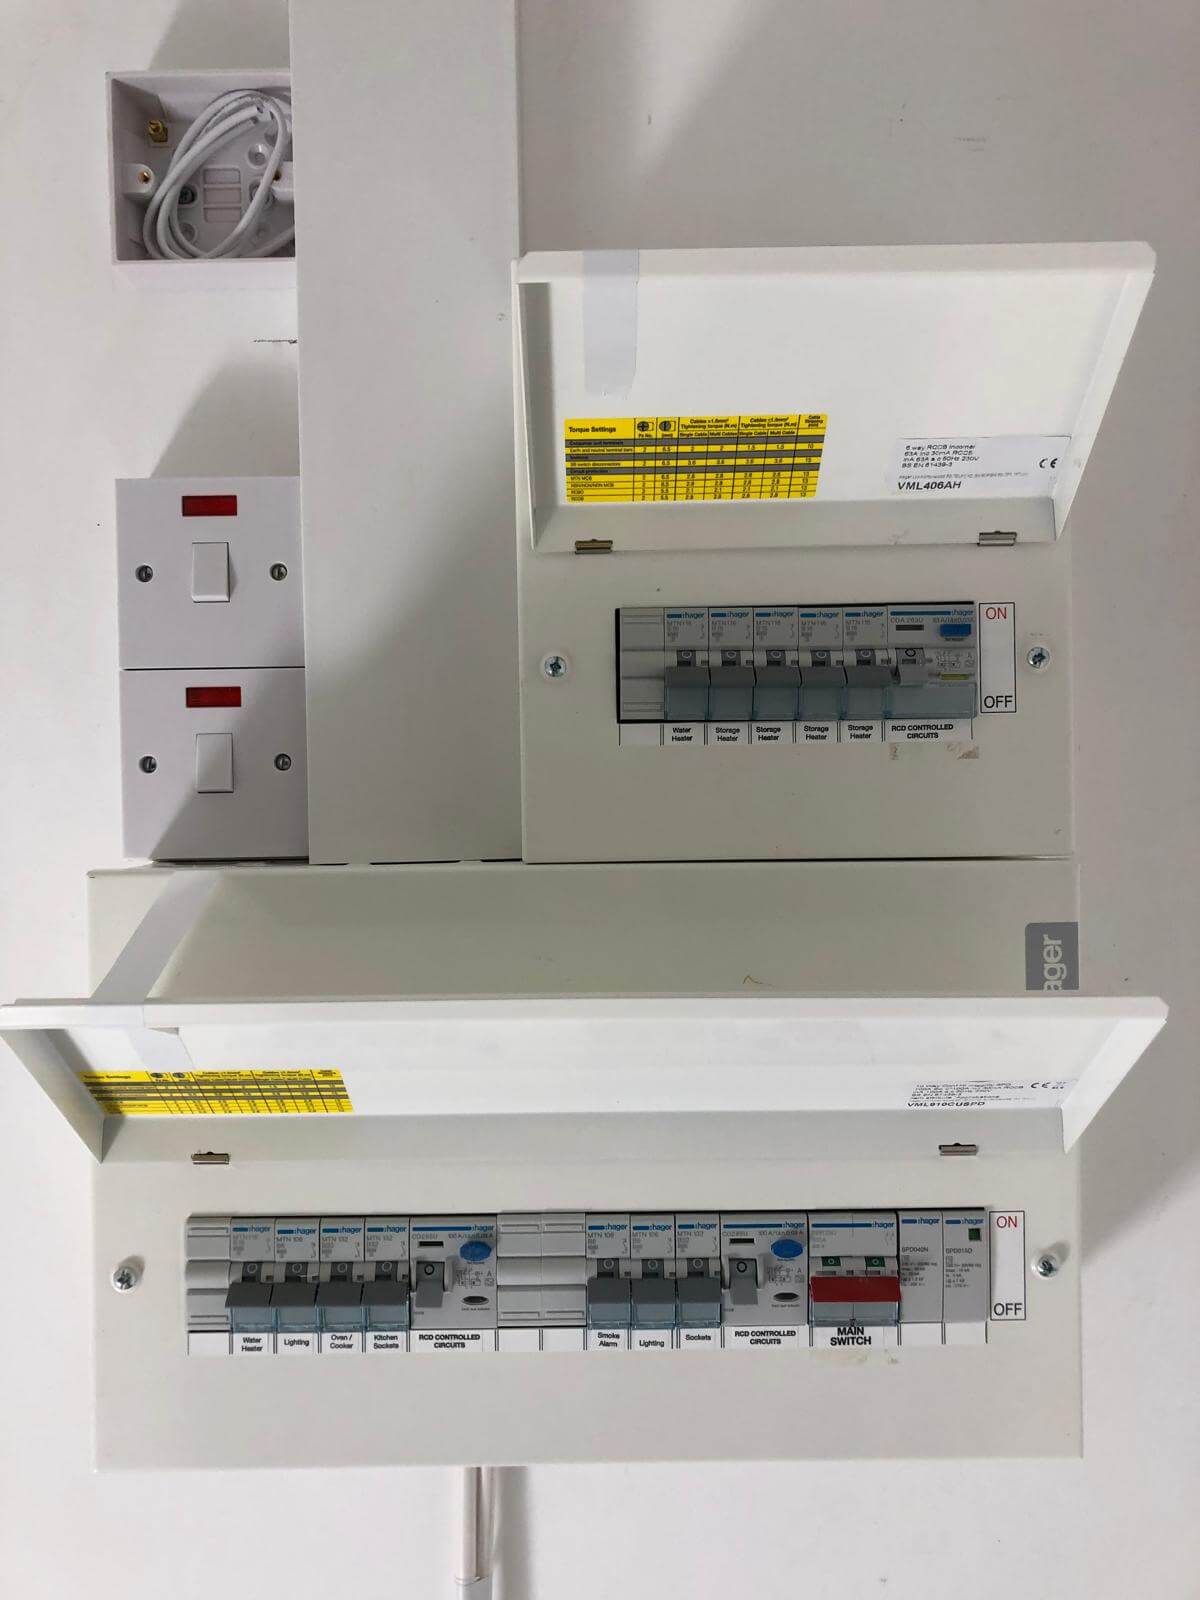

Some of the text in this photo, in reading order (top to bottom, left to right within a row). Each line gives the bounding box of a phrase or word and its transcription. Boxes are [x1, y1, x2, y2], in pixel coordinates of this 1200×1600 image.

[568, 426, 589, 434] Torque
[898, 481, 962, 490] VML406AH
[985, 607, 1007, 620] ON
[984, 695, 1013, 709] OFF
[715, 727, 740, 735] Storage
[756, 726, 782, 734] Storage
[803, 725, 829, 733] Storage
[847, 724, 874, 732] Storage
[996, 1216, 1018, 1229] ON
[993, 1302, 1023, 1316] OFF
[837, 1327, 864, 1336] MAIN
[242, 1336, 262, 1344] Water
[284, 1338, 310, 1347] Lighting
[599, 1340, 618, 1348] Alarm
[639, 1340, 665, 1348] Lighting
[830, 1336, 872, 1346] SWITCH
[241, 1344, 263, 1352] Heater
